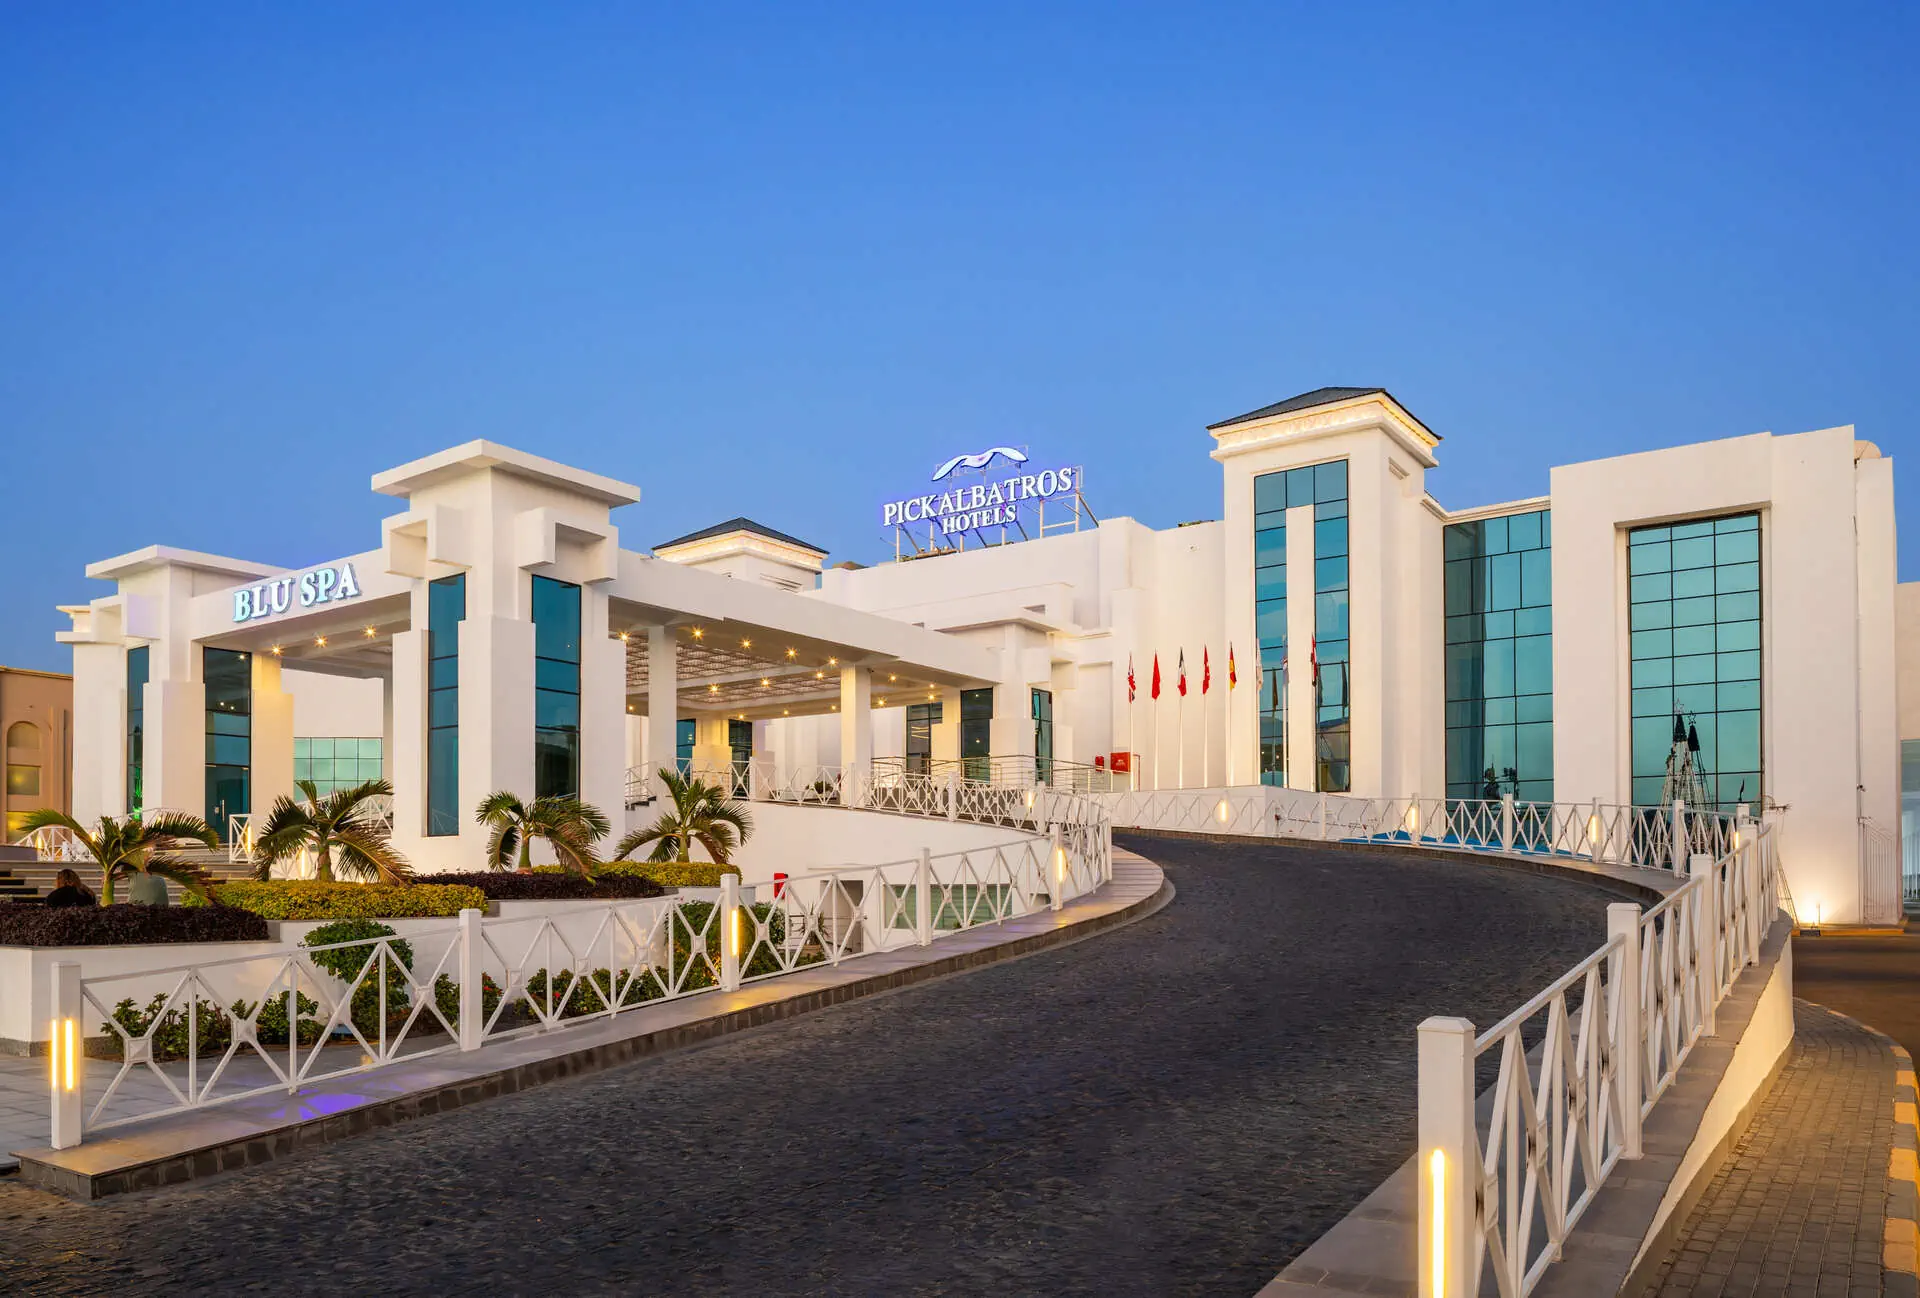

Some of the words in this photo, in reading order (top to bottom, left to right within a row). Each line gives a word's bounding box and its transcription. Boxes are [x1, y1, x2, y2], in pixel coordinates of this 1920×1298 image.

[883, 467, 1073, 526] PICKALBATROS
[942, 505, 1017, 535] HOTELS
[233, 577, 295, 623] BLU
[300, 562, 362, 607] SPA
